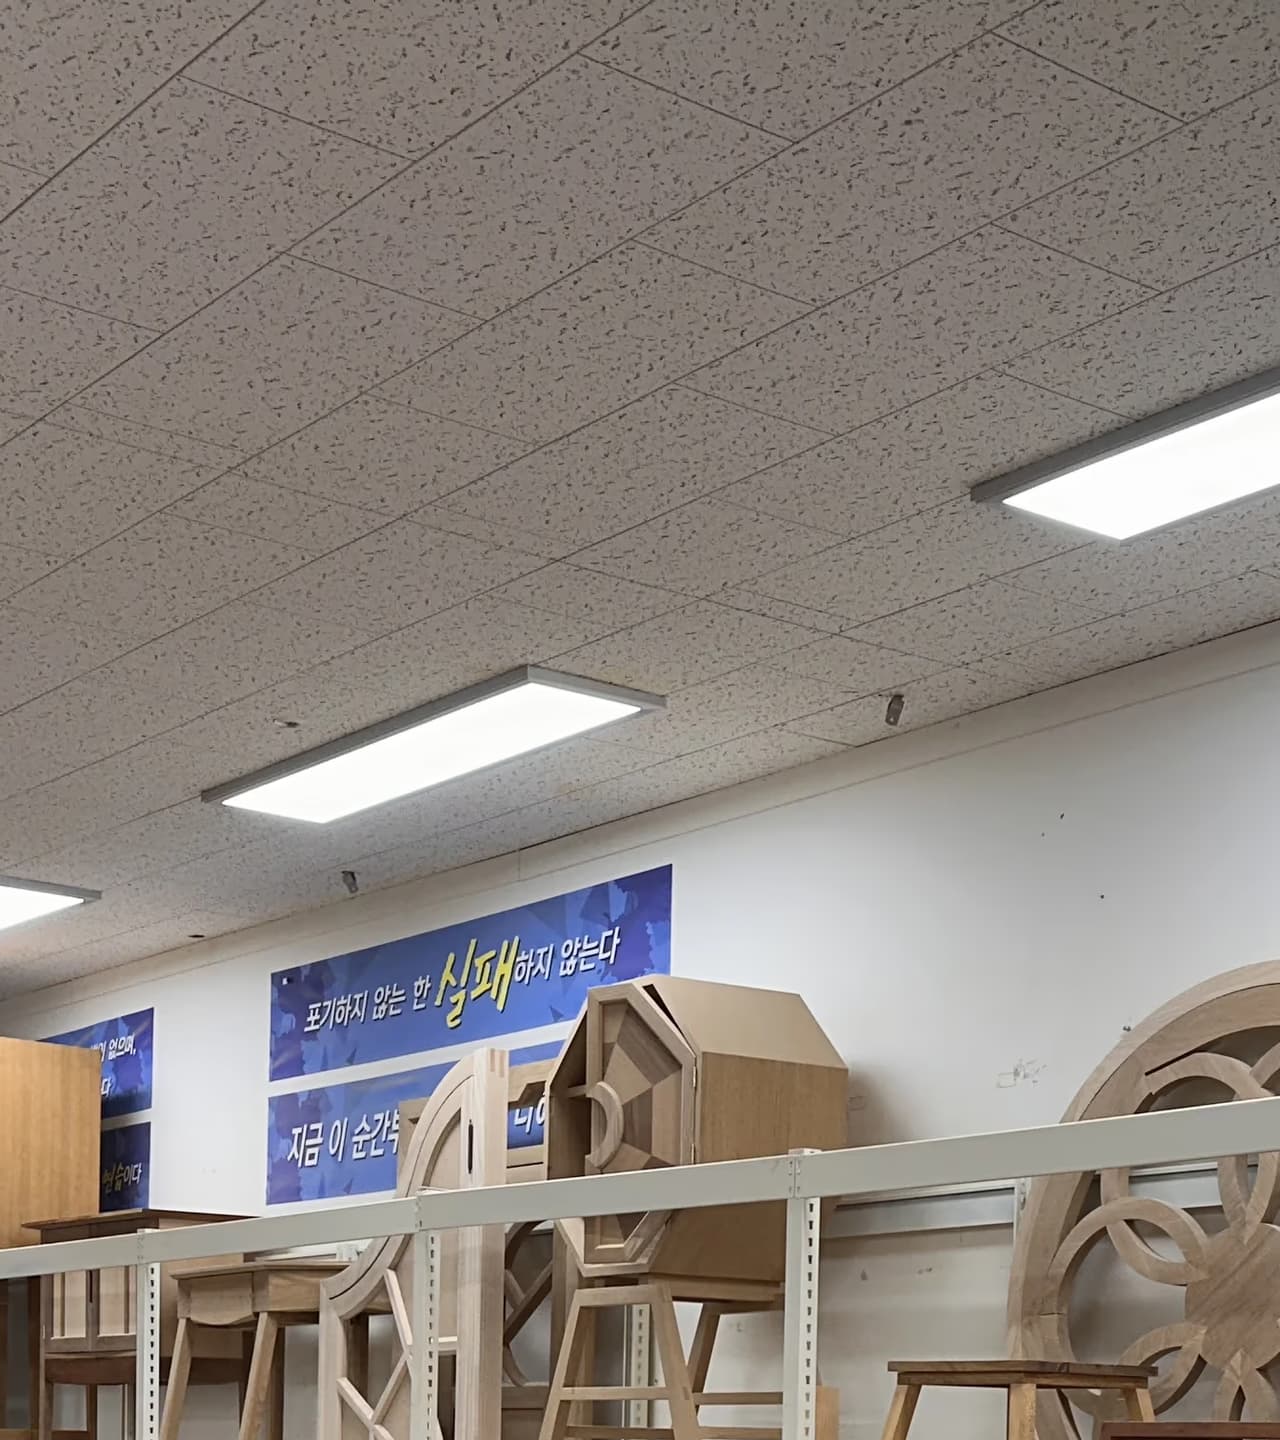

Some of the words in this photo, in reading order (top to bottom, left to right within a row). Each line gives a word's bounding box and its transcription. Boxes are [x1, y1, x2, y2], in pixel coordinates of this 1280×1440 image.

[304, 990, 369, 1032] 포기하지
[372, 983, 407, 1020] 않는
[413, 975, 432, 1012] 한
[558, 926, 621, 977] 않는다
[287, 1121, 324, 1168] 지금
[329, 1116, 349, 1162] 이
